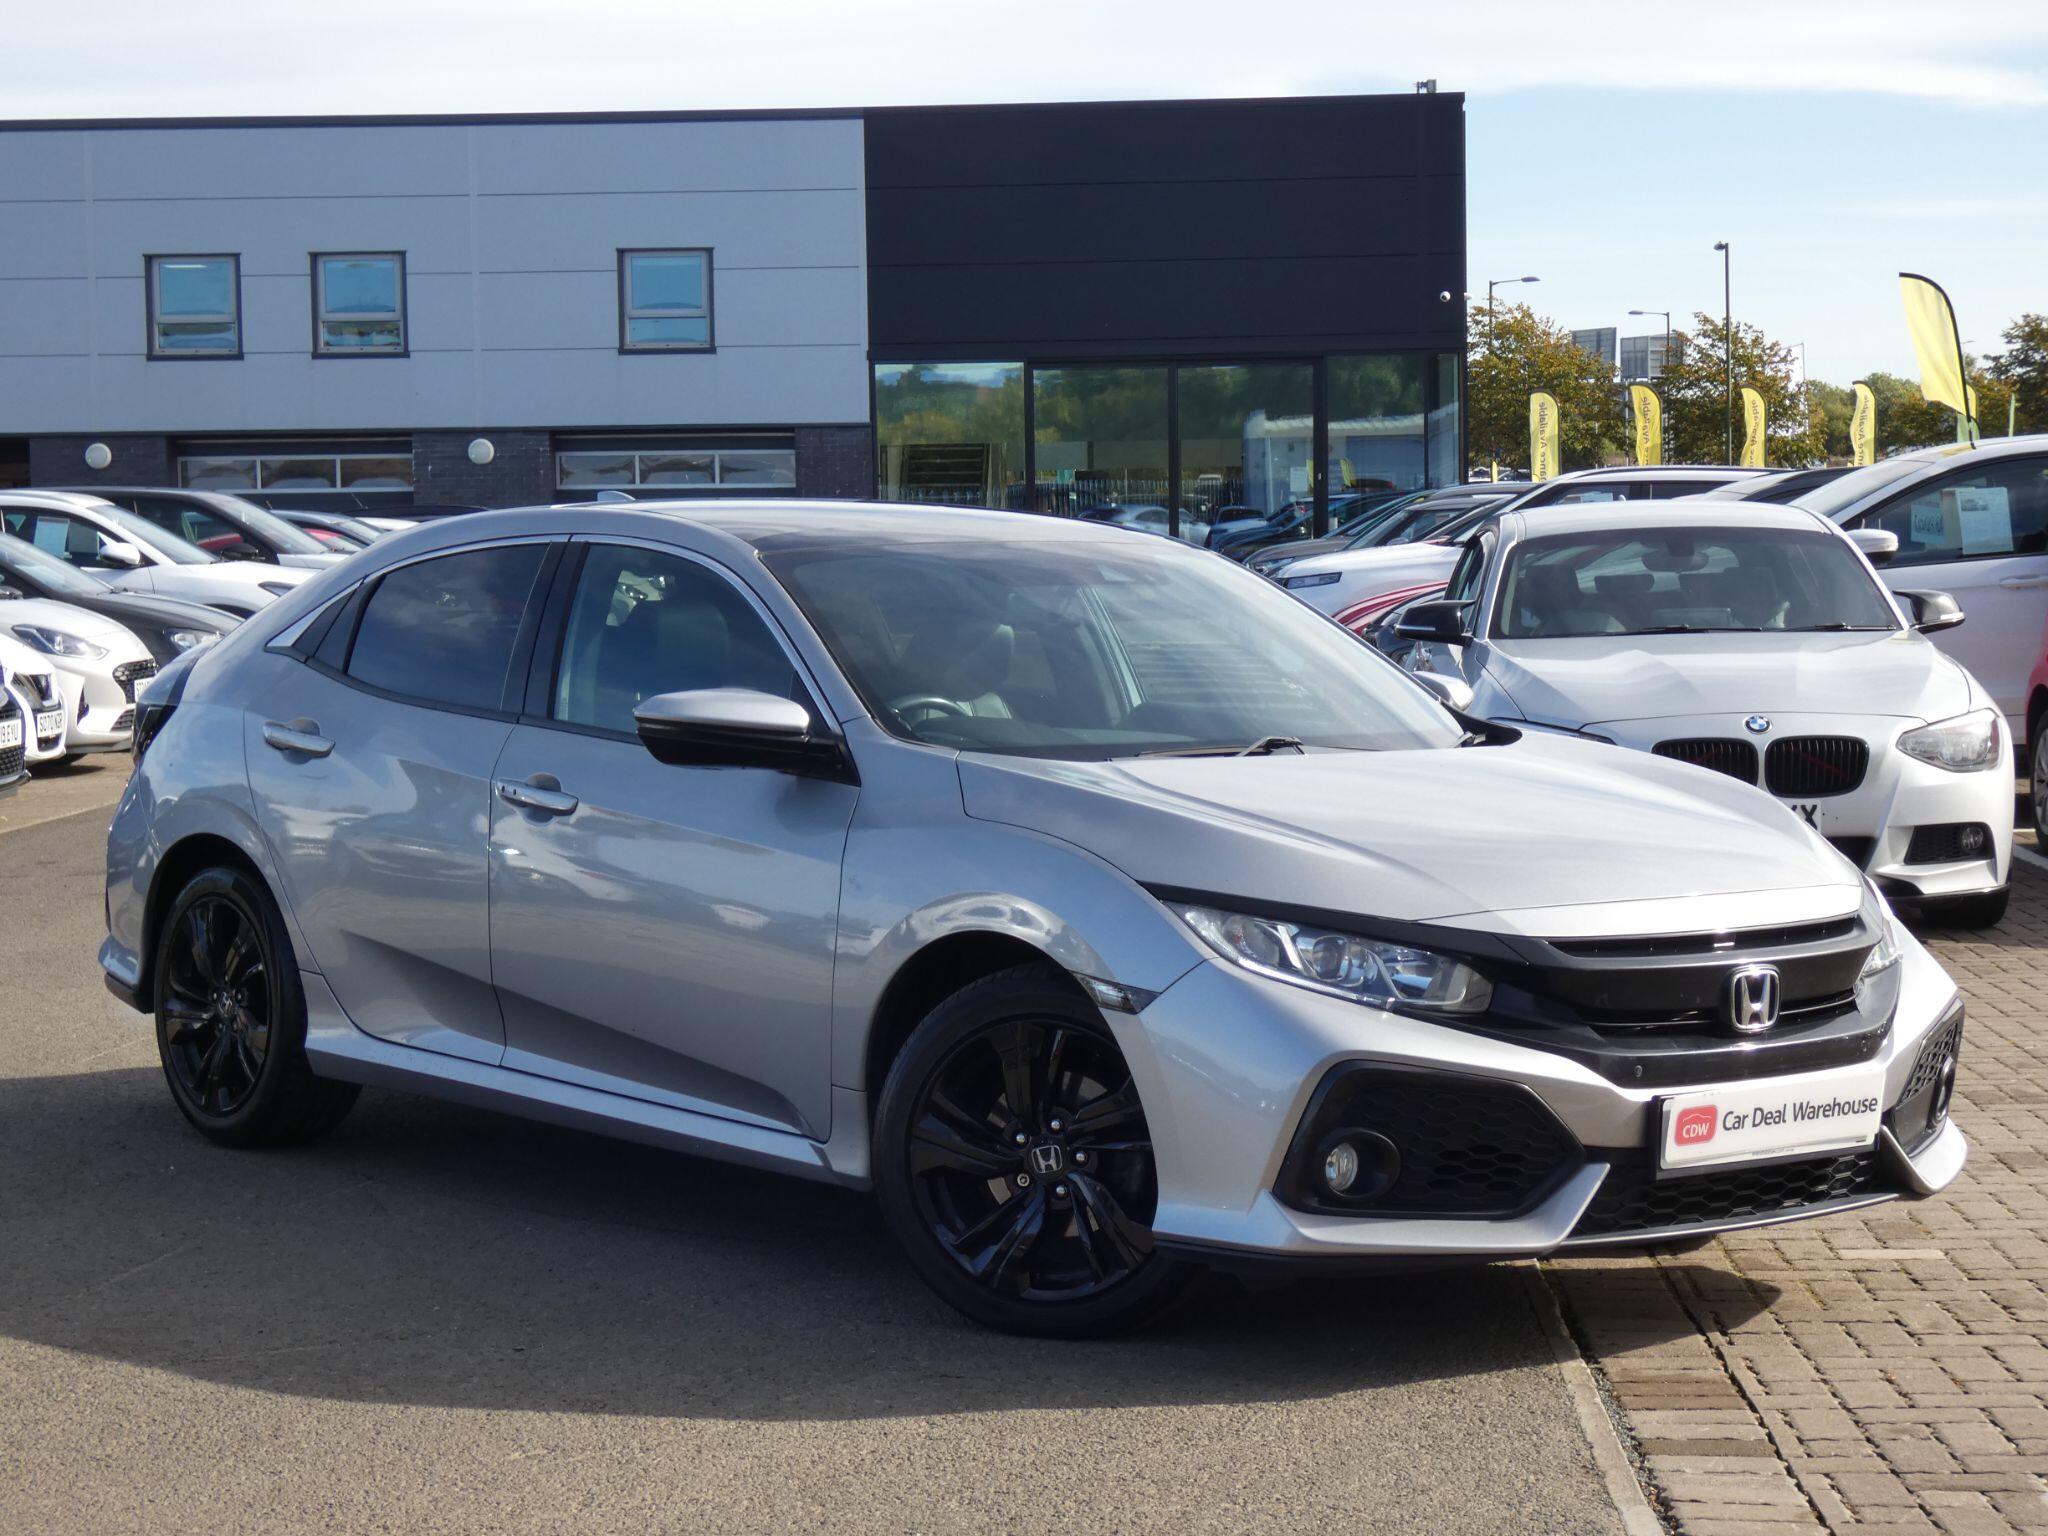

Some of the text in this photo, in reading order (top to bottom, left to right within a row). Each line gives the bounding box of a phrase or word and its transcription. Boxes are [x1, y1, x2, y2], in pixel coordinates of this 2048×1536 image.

[1722, 1097, 1878, 1132] Car Deal Warehouse
[1682, 1122, 1710, 1139] CDW
